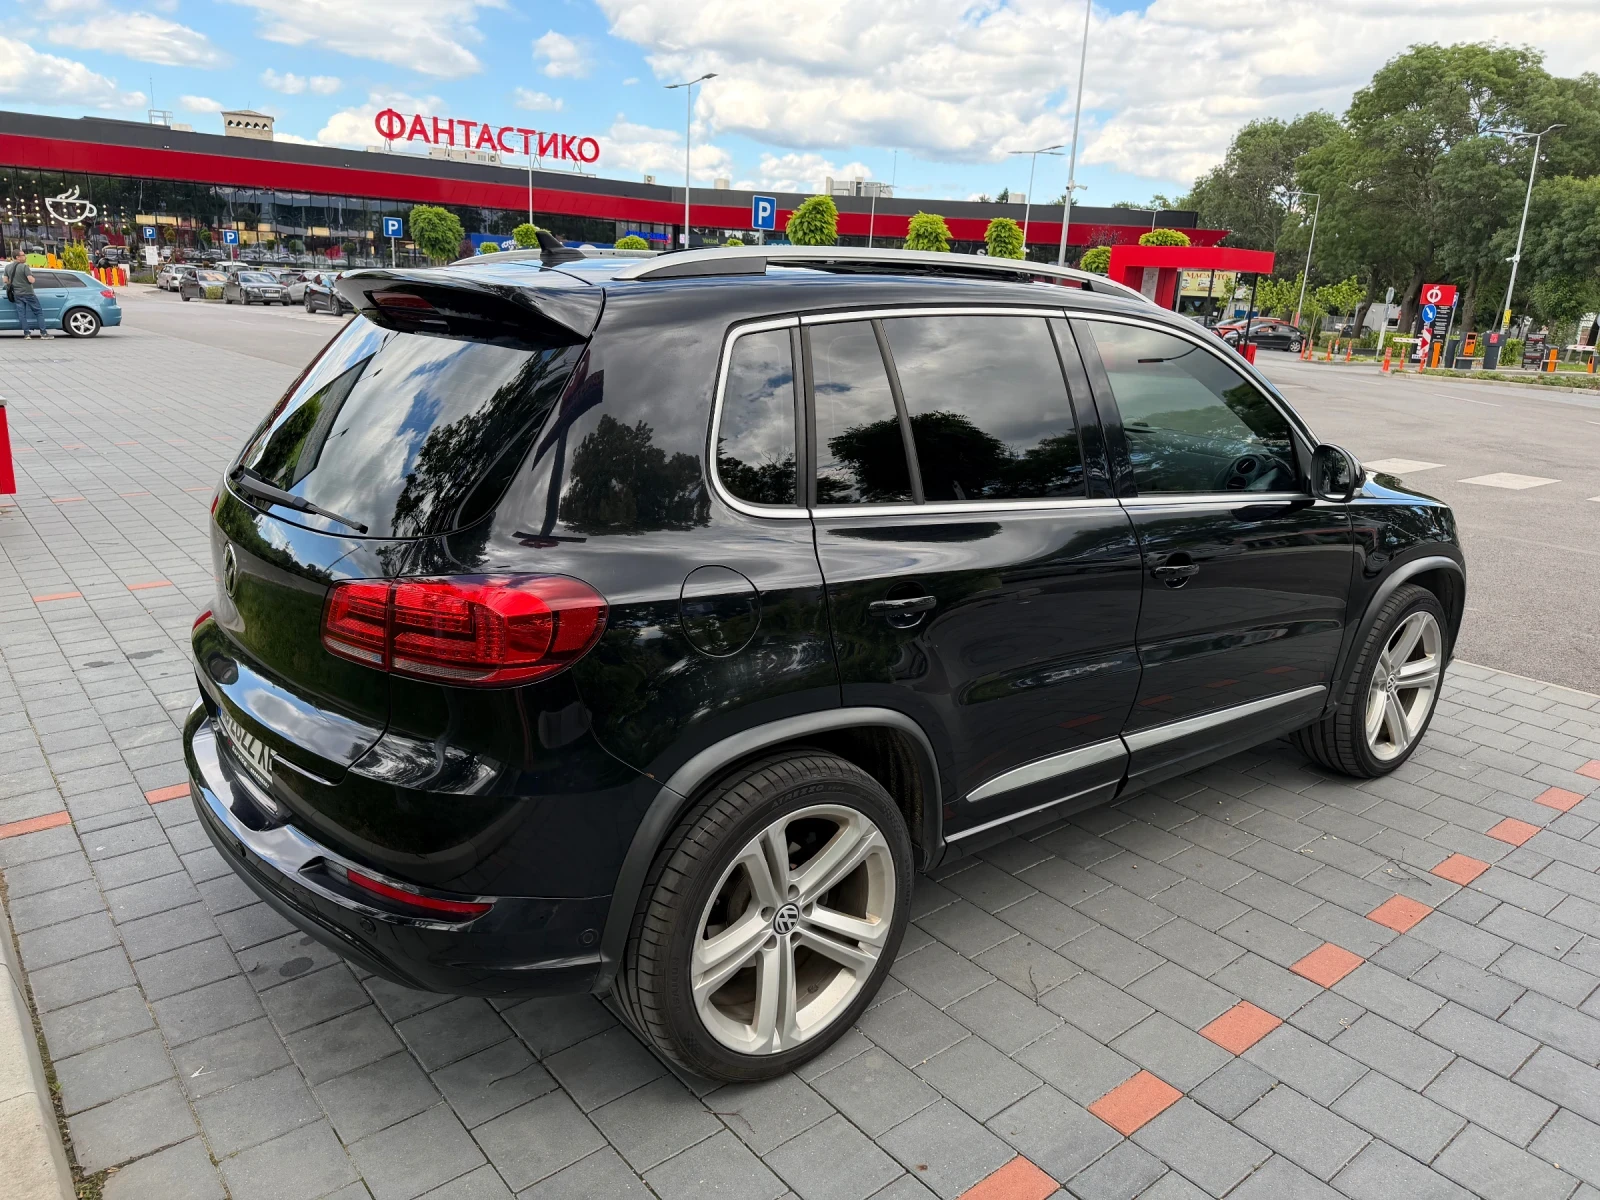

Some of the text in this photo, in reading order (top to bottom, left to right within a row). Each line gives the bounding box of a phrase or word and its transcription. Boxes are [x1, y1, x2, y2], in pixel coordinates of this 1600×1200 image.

[375, 108, 600, 163] ФАНТАСТИКО
[758, 201, 771, 225] P
[146, 228, 153, 237] P
[388, 220, 399, 235] P
[226, 232, 235, 243] P
